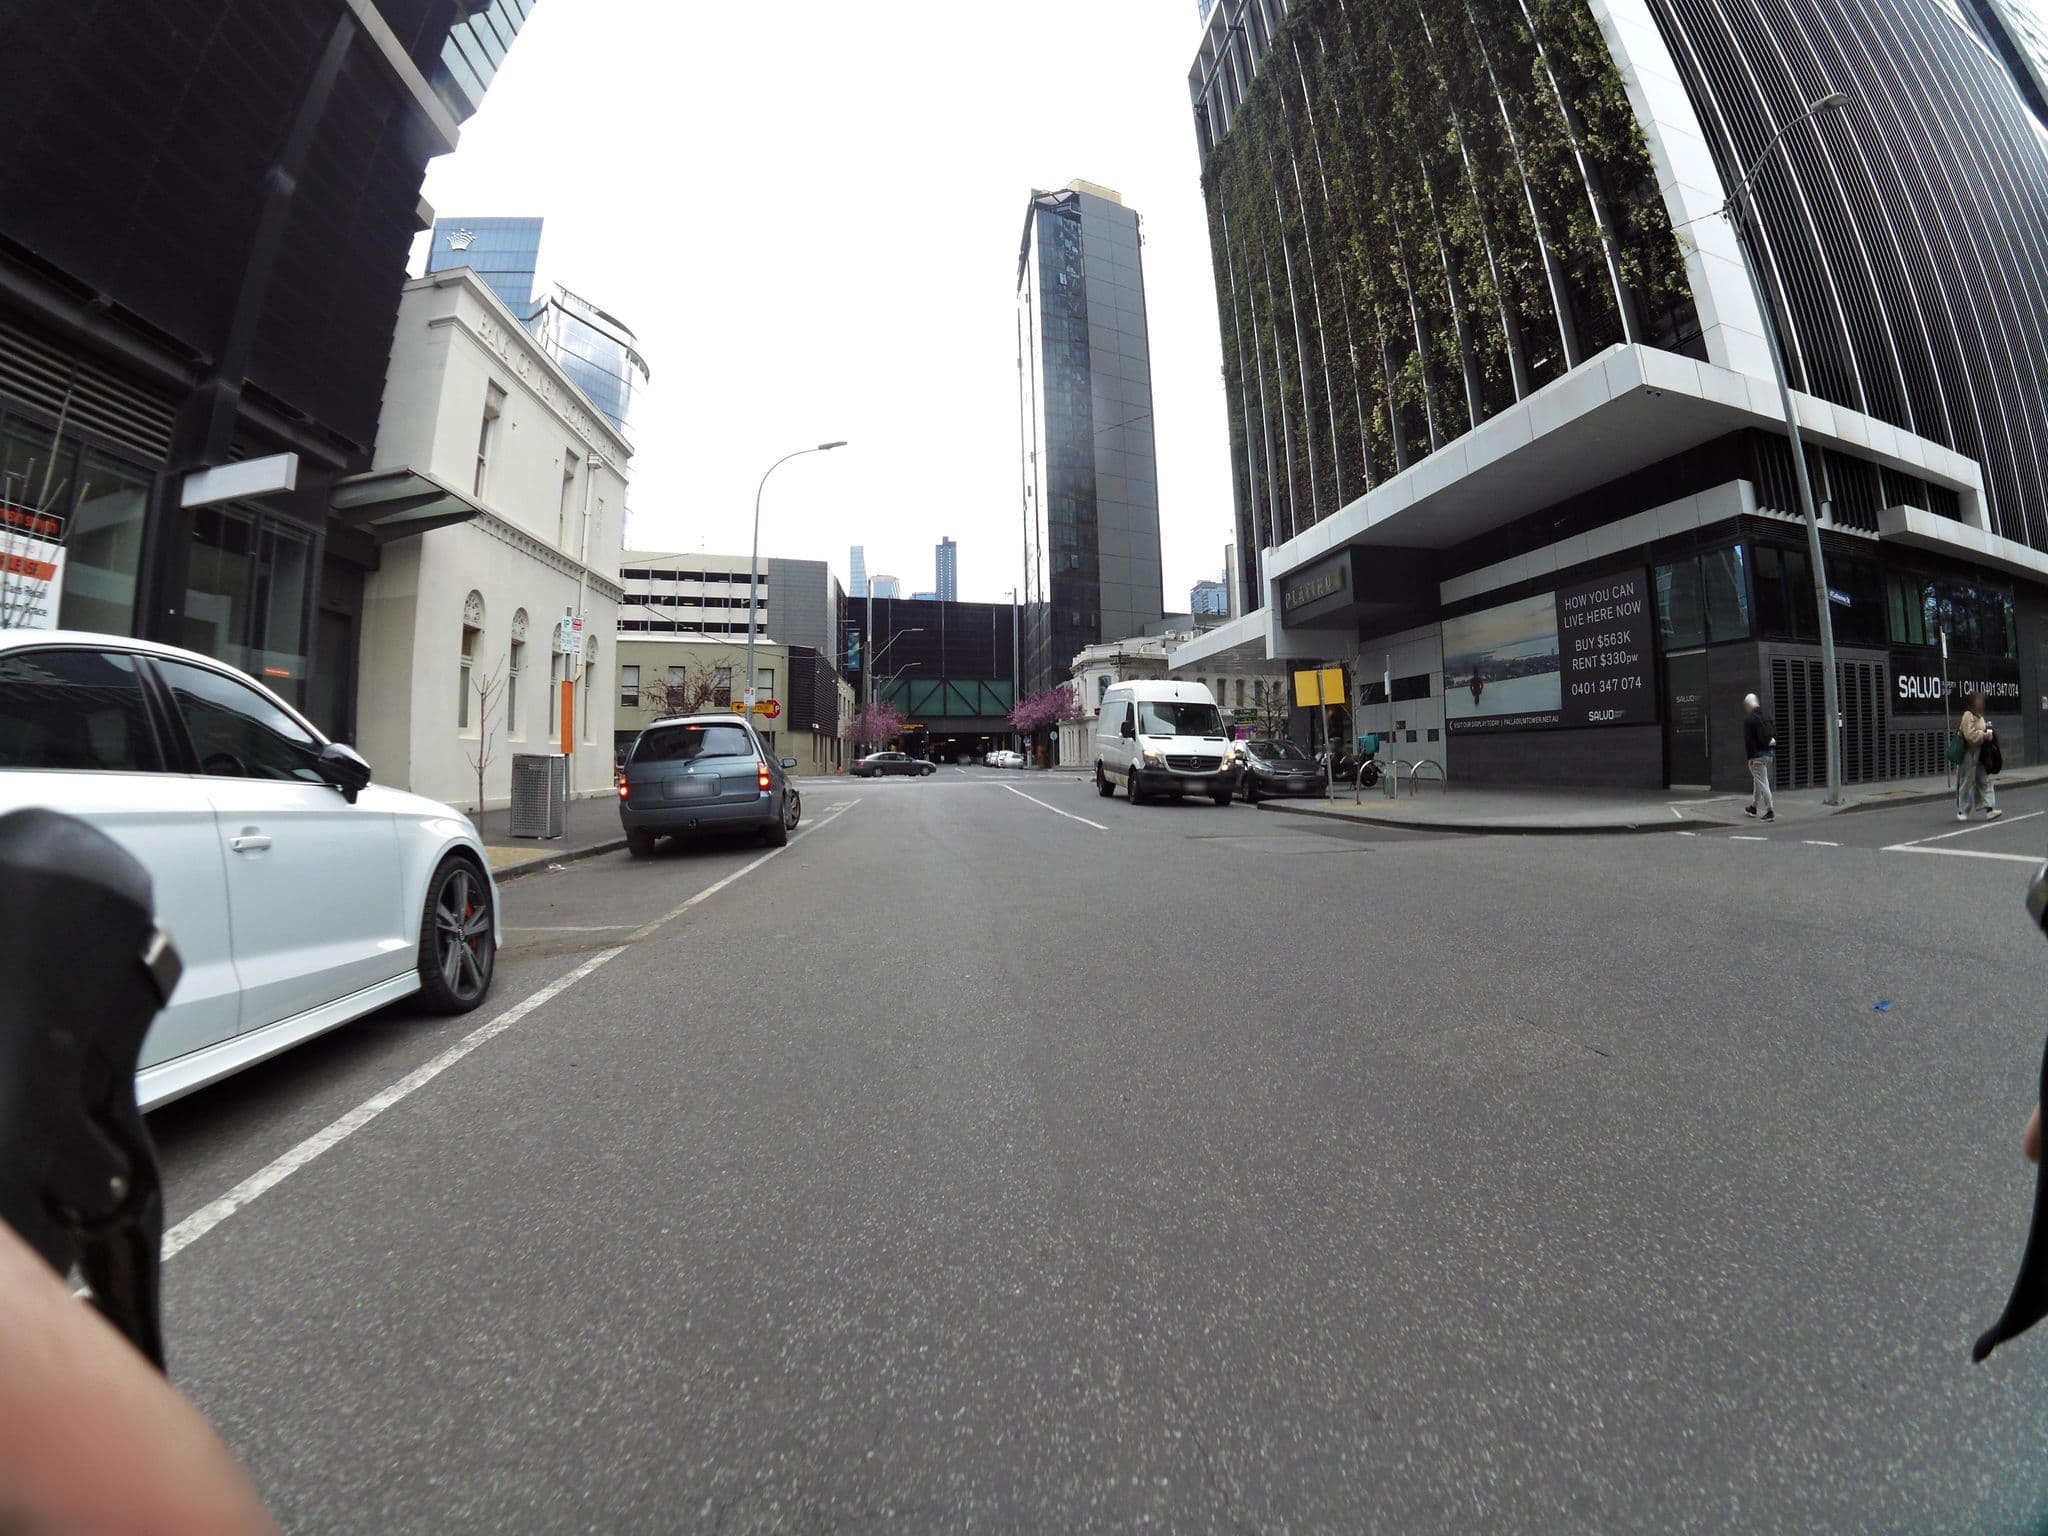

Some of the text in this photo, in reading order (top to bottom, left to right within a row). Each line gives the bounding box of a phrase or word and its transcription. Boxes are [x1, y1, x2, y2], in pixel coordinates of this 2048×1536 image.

[1565, 582, 1634, 611] HOW YOU CAN
[1564, 600, 1641, 629] LIVE HERE NOW
[1575, 630, 1631, 652] BUY $563K
[1572, 651, 1639, 670] RENT $330pw
[1571, 676, 1642, 696] 0401 347 074
[1898, 675, 1941, 698] SALVO
